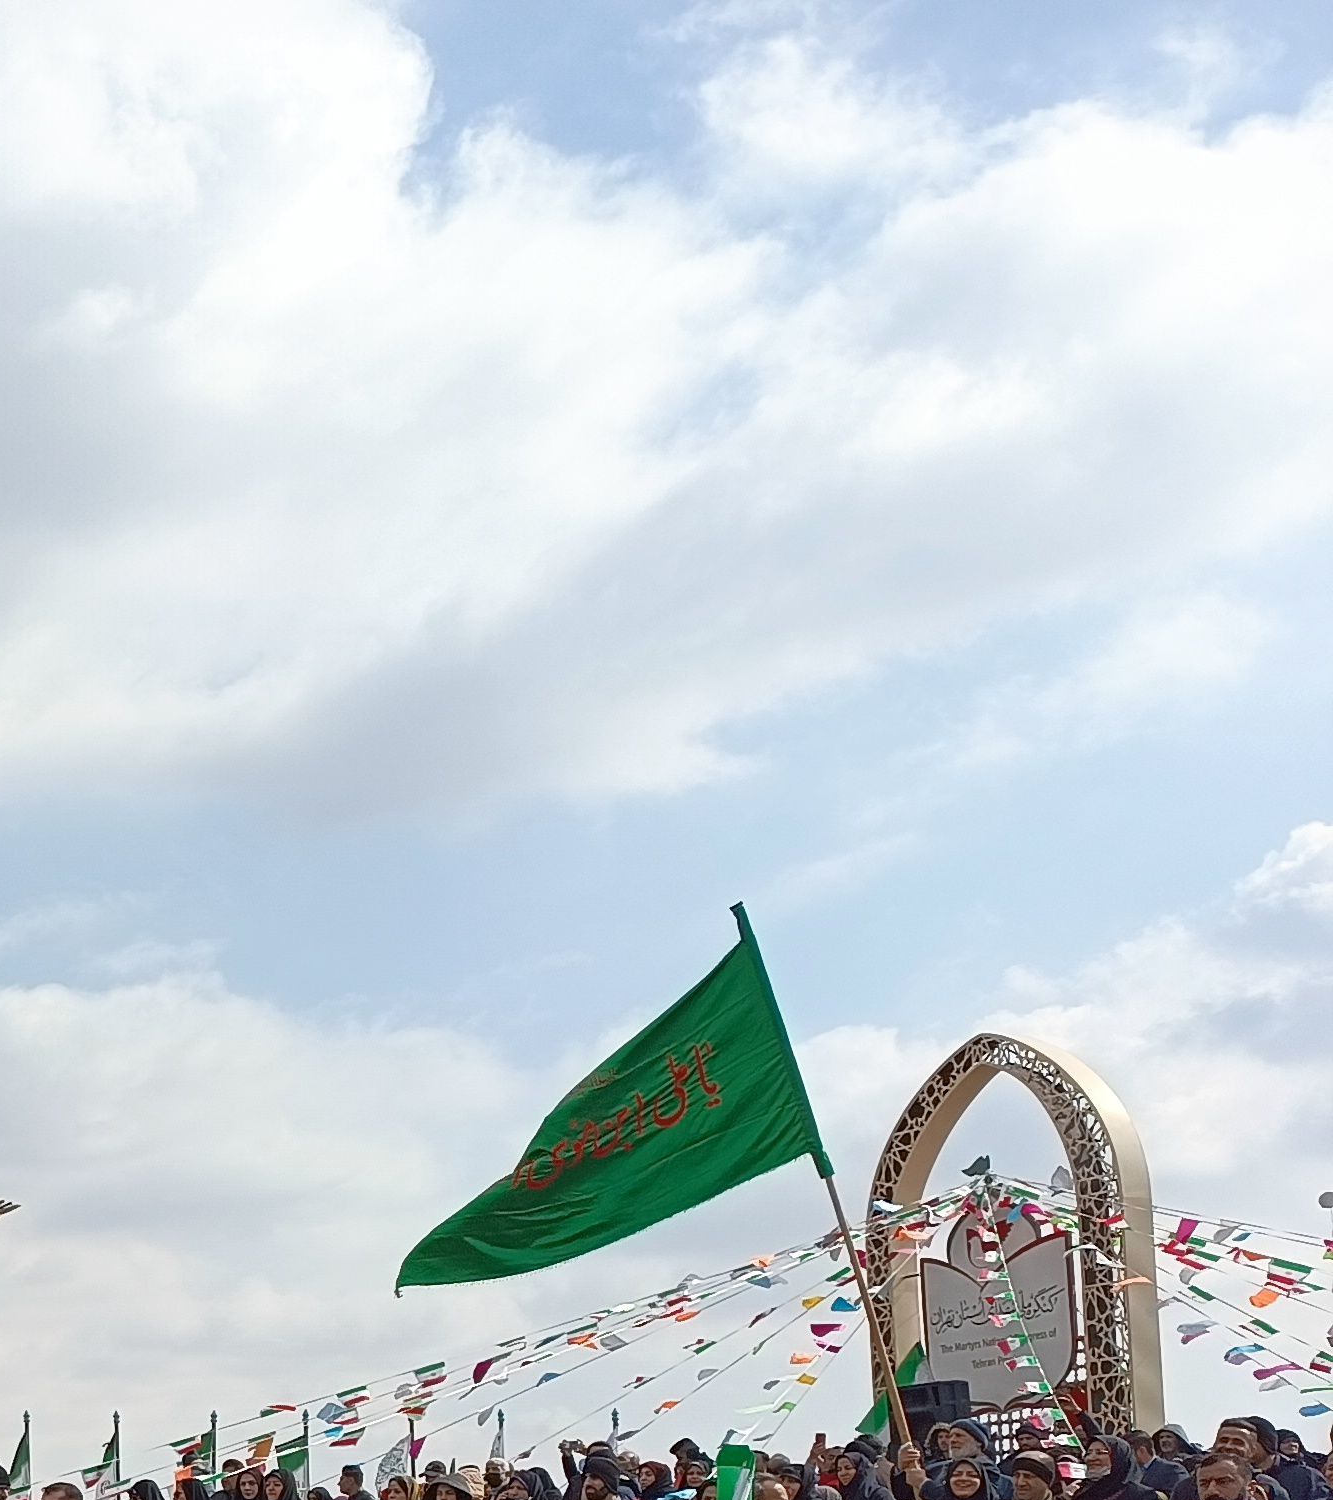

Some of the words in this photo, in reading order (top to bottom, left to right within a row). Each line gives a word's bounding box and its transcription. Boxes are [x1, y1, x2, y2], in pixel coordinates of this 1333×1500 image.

[940, 1344, 954, 1354] The
[955, 1340, 982, 1352] Martyrs
[972, 1358, 997, 1369] Tehran
